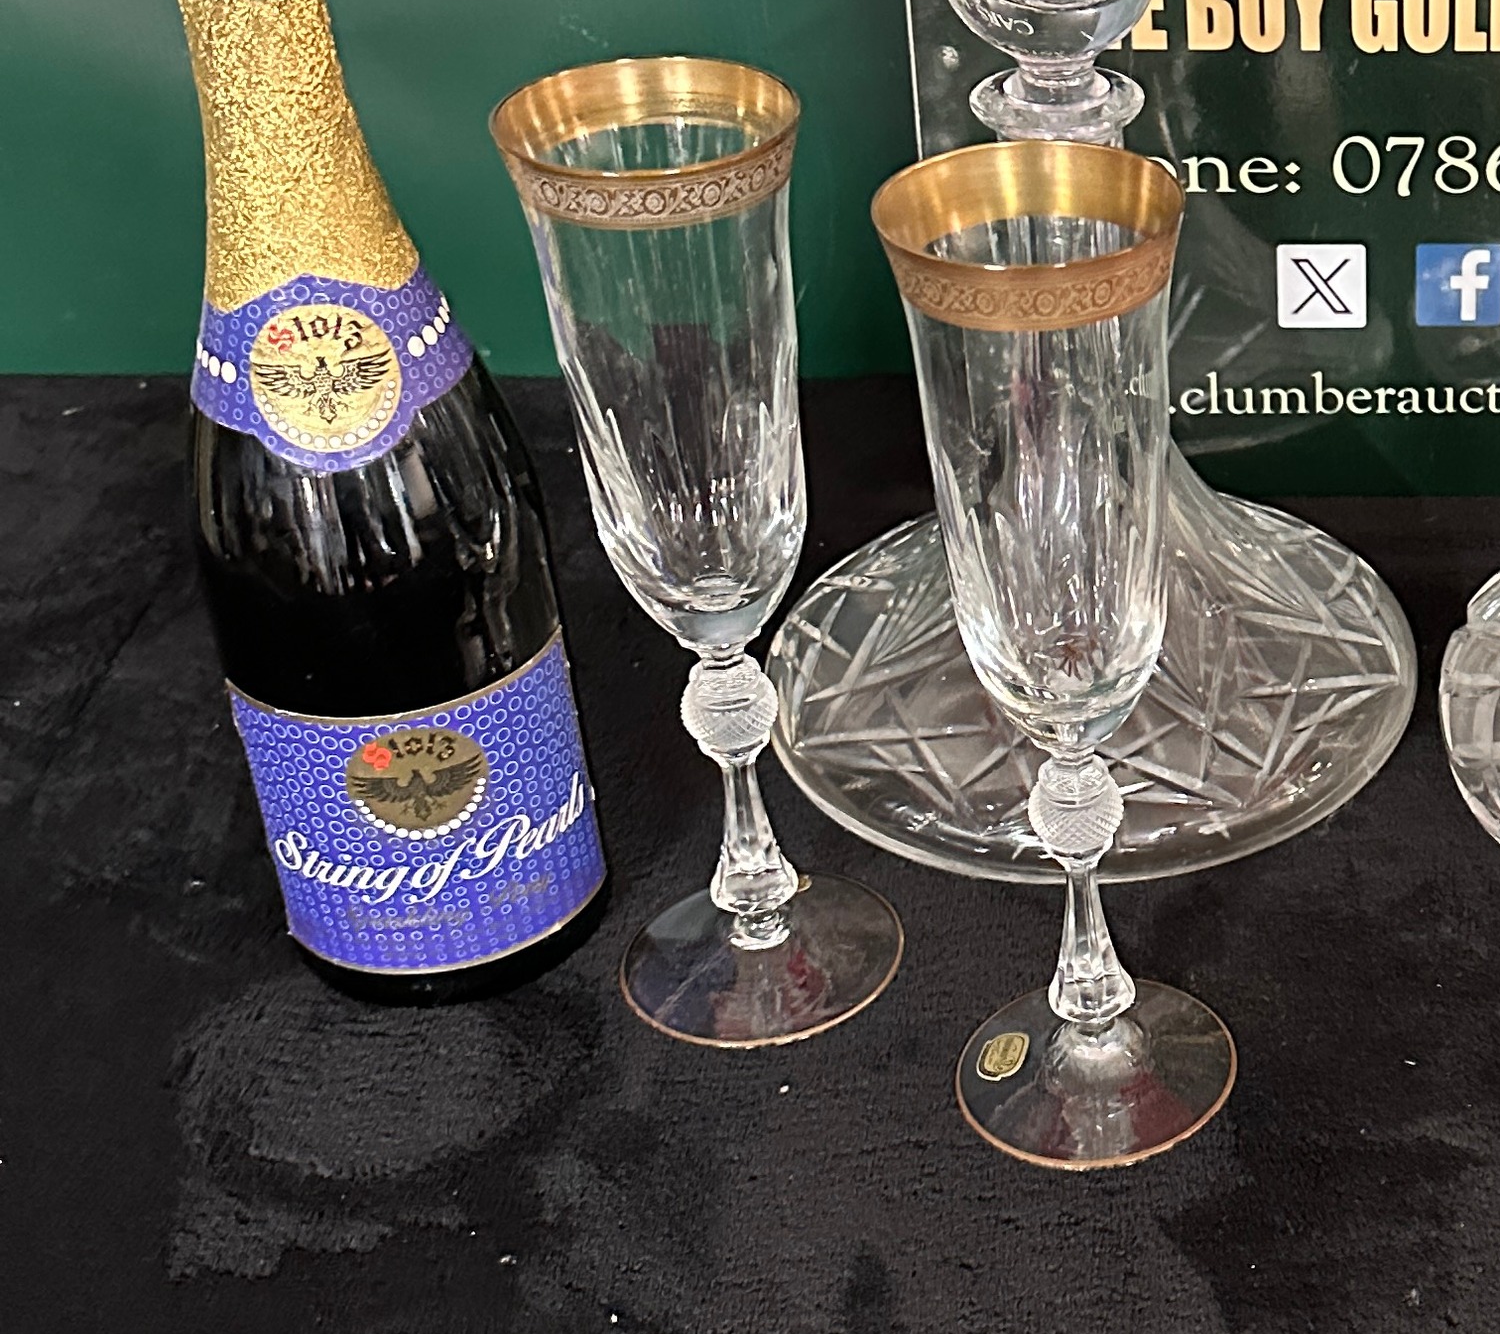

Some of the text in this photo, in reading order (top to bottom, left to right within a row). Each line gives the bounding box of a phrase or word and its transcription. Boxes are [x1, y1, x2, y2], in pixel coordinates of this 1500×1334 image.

[274, 830, 402, 904] String
[409, 838, 472, 904] of
[461, 771, 585, 881] Pearls
